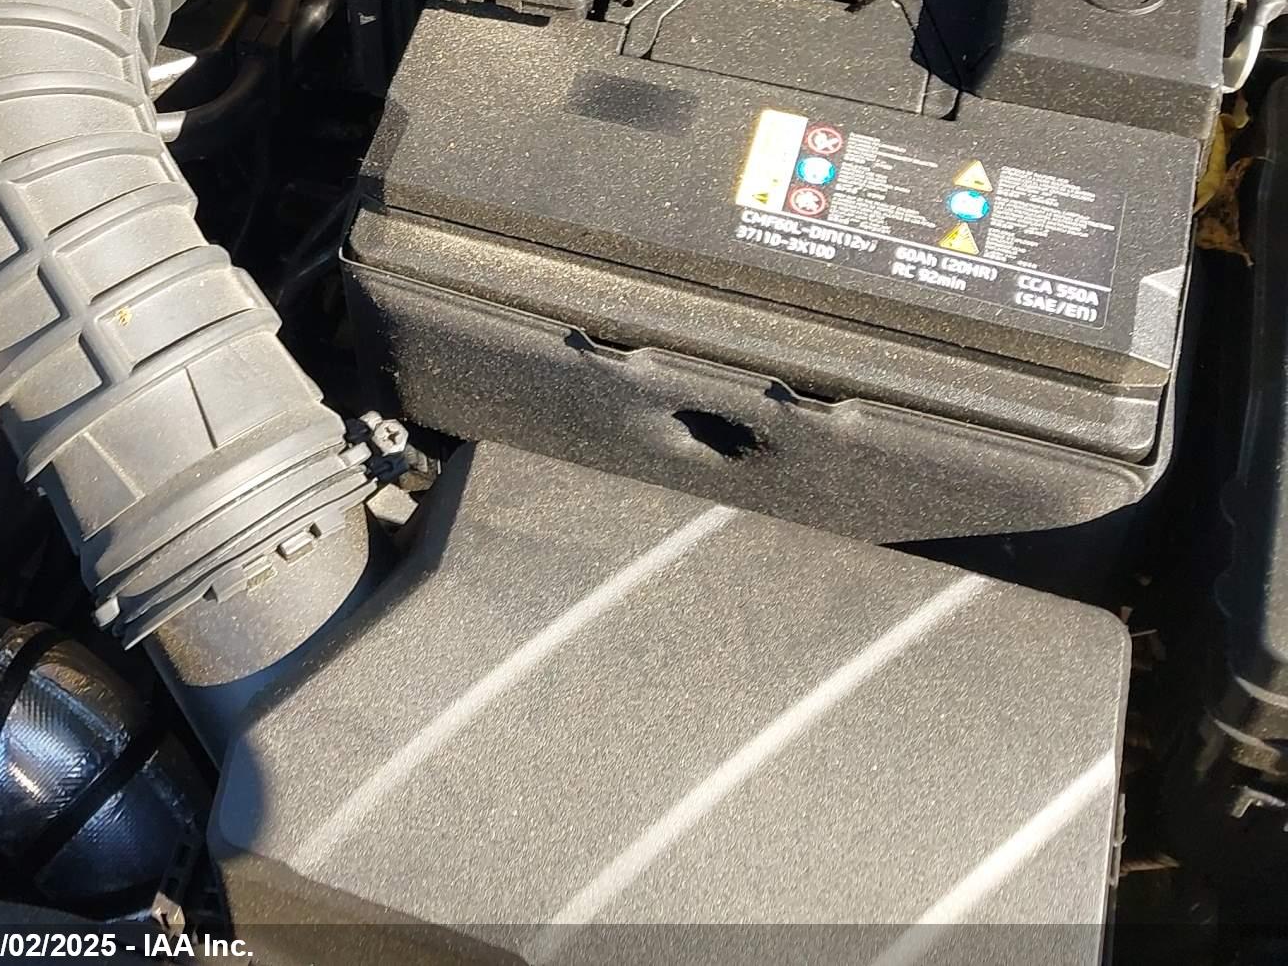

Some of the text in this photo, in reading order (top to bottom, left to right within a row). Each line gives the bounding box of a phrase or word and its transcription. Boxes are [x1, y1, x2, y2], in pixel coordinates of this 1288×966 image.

[891, 262, 966, 291] RC 92min
[895, 246, 998, 281] 60Ah (20HR)
[1017, 275, 1099, 306] CCA 550A
